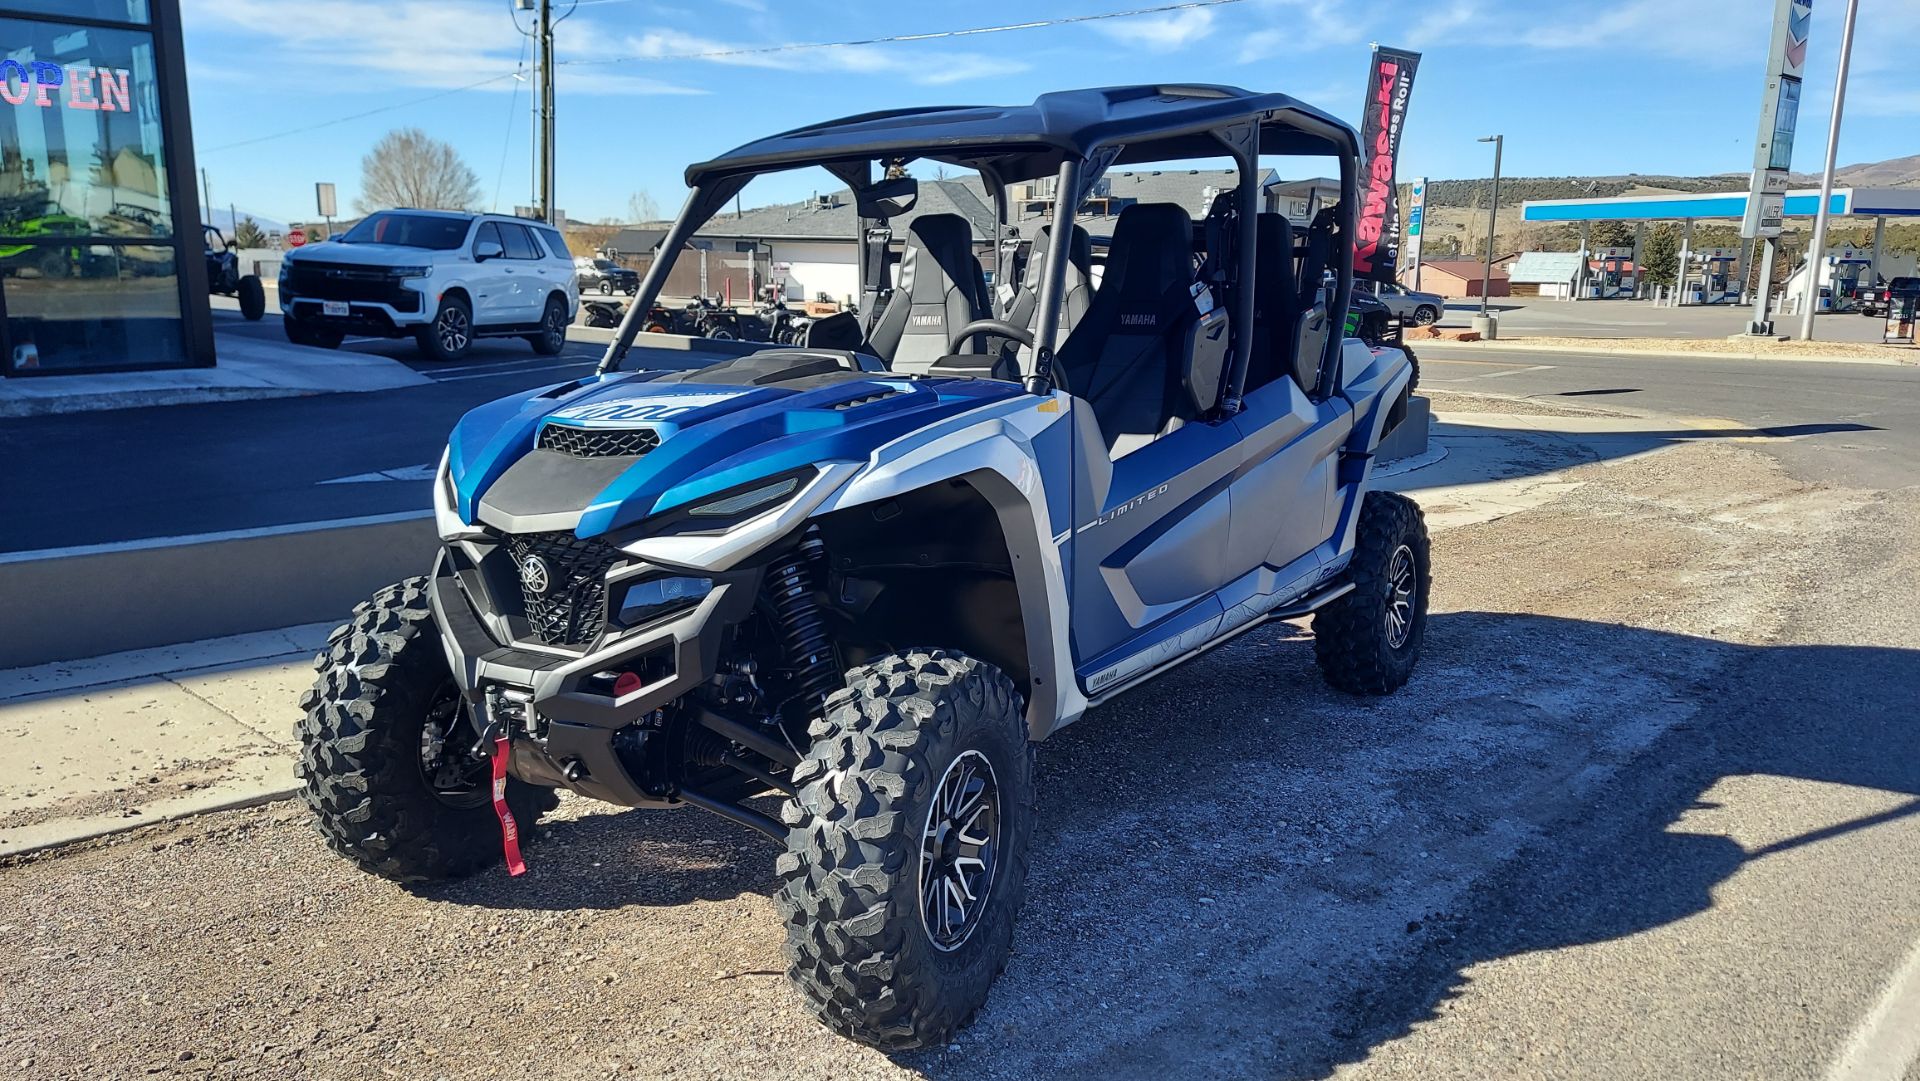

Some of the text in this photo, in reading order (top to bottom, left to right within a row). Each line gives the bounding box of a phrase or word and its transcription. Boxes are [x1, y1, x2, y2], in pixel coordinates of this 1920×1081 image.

[0, 59, 131, 112] OPEN
[288, 233, 306, 244] STOP
[1383, 242, 1399, 268] Let
[912, 315, 942, 327] YAMAHA
[1120, 314, 1156, 326] YAMAHA
[1098, 484, 1169, 526] LIMITED
[1092, 668, 1118, 688] YAMAHA
[503, 812, 516, 842] WARN
